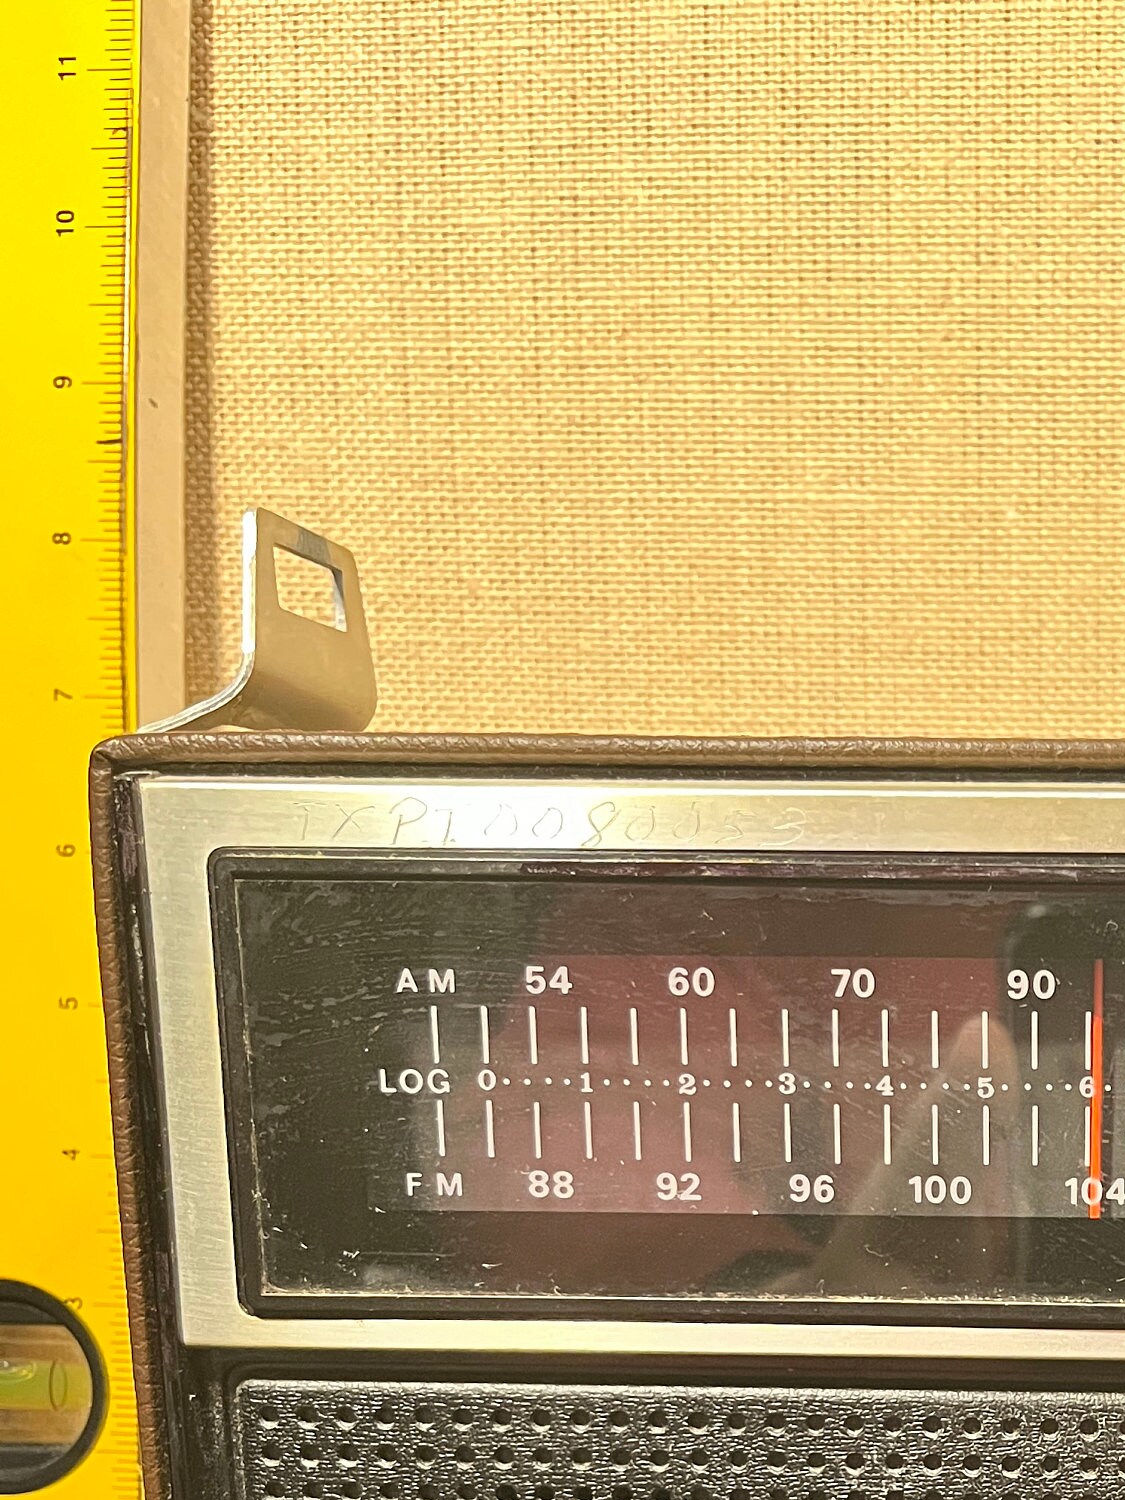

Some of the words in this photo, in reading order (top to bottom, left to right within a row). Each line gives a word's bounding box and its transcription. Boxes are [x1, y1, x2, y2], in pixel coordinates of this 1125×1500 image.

[57, 54, 77, 80] 11
[56, 209, 75, 238] 10
[53, 375, 73, 390] 9
[52, 531, 72, 546] 8
[53, 688, 74, 702] 7
[56, 843, 76, 858] 6
[525, 966, 572, 994] 54
[668, 966, 715, 997] 60
[831, 968, 876, 998] 70
[1007, 969, 1056, 1000] 90
[59, 996, 79, 1011] 5
[379, 1068, 450, 1094] LOG
[478, 1069, 496, 1091] 0
[580, 1073, 594, 1093] 1
[678, 1073, 697, 1095] 2
[778, 1074, 797, 1095] 3
[876, 1075, 894, 1096] 4
[977, 1077, 995, 1098] 5
[1079, 1076, 1096, 1098] 6
[62, 1147, 80, 1161] 4
[528, 1170, 574, 1199] 88
[656, 1172, 702, 1201] 92
[789, 1174, 835, 1203] 96
[909, 1175, 972, 1205] 100
